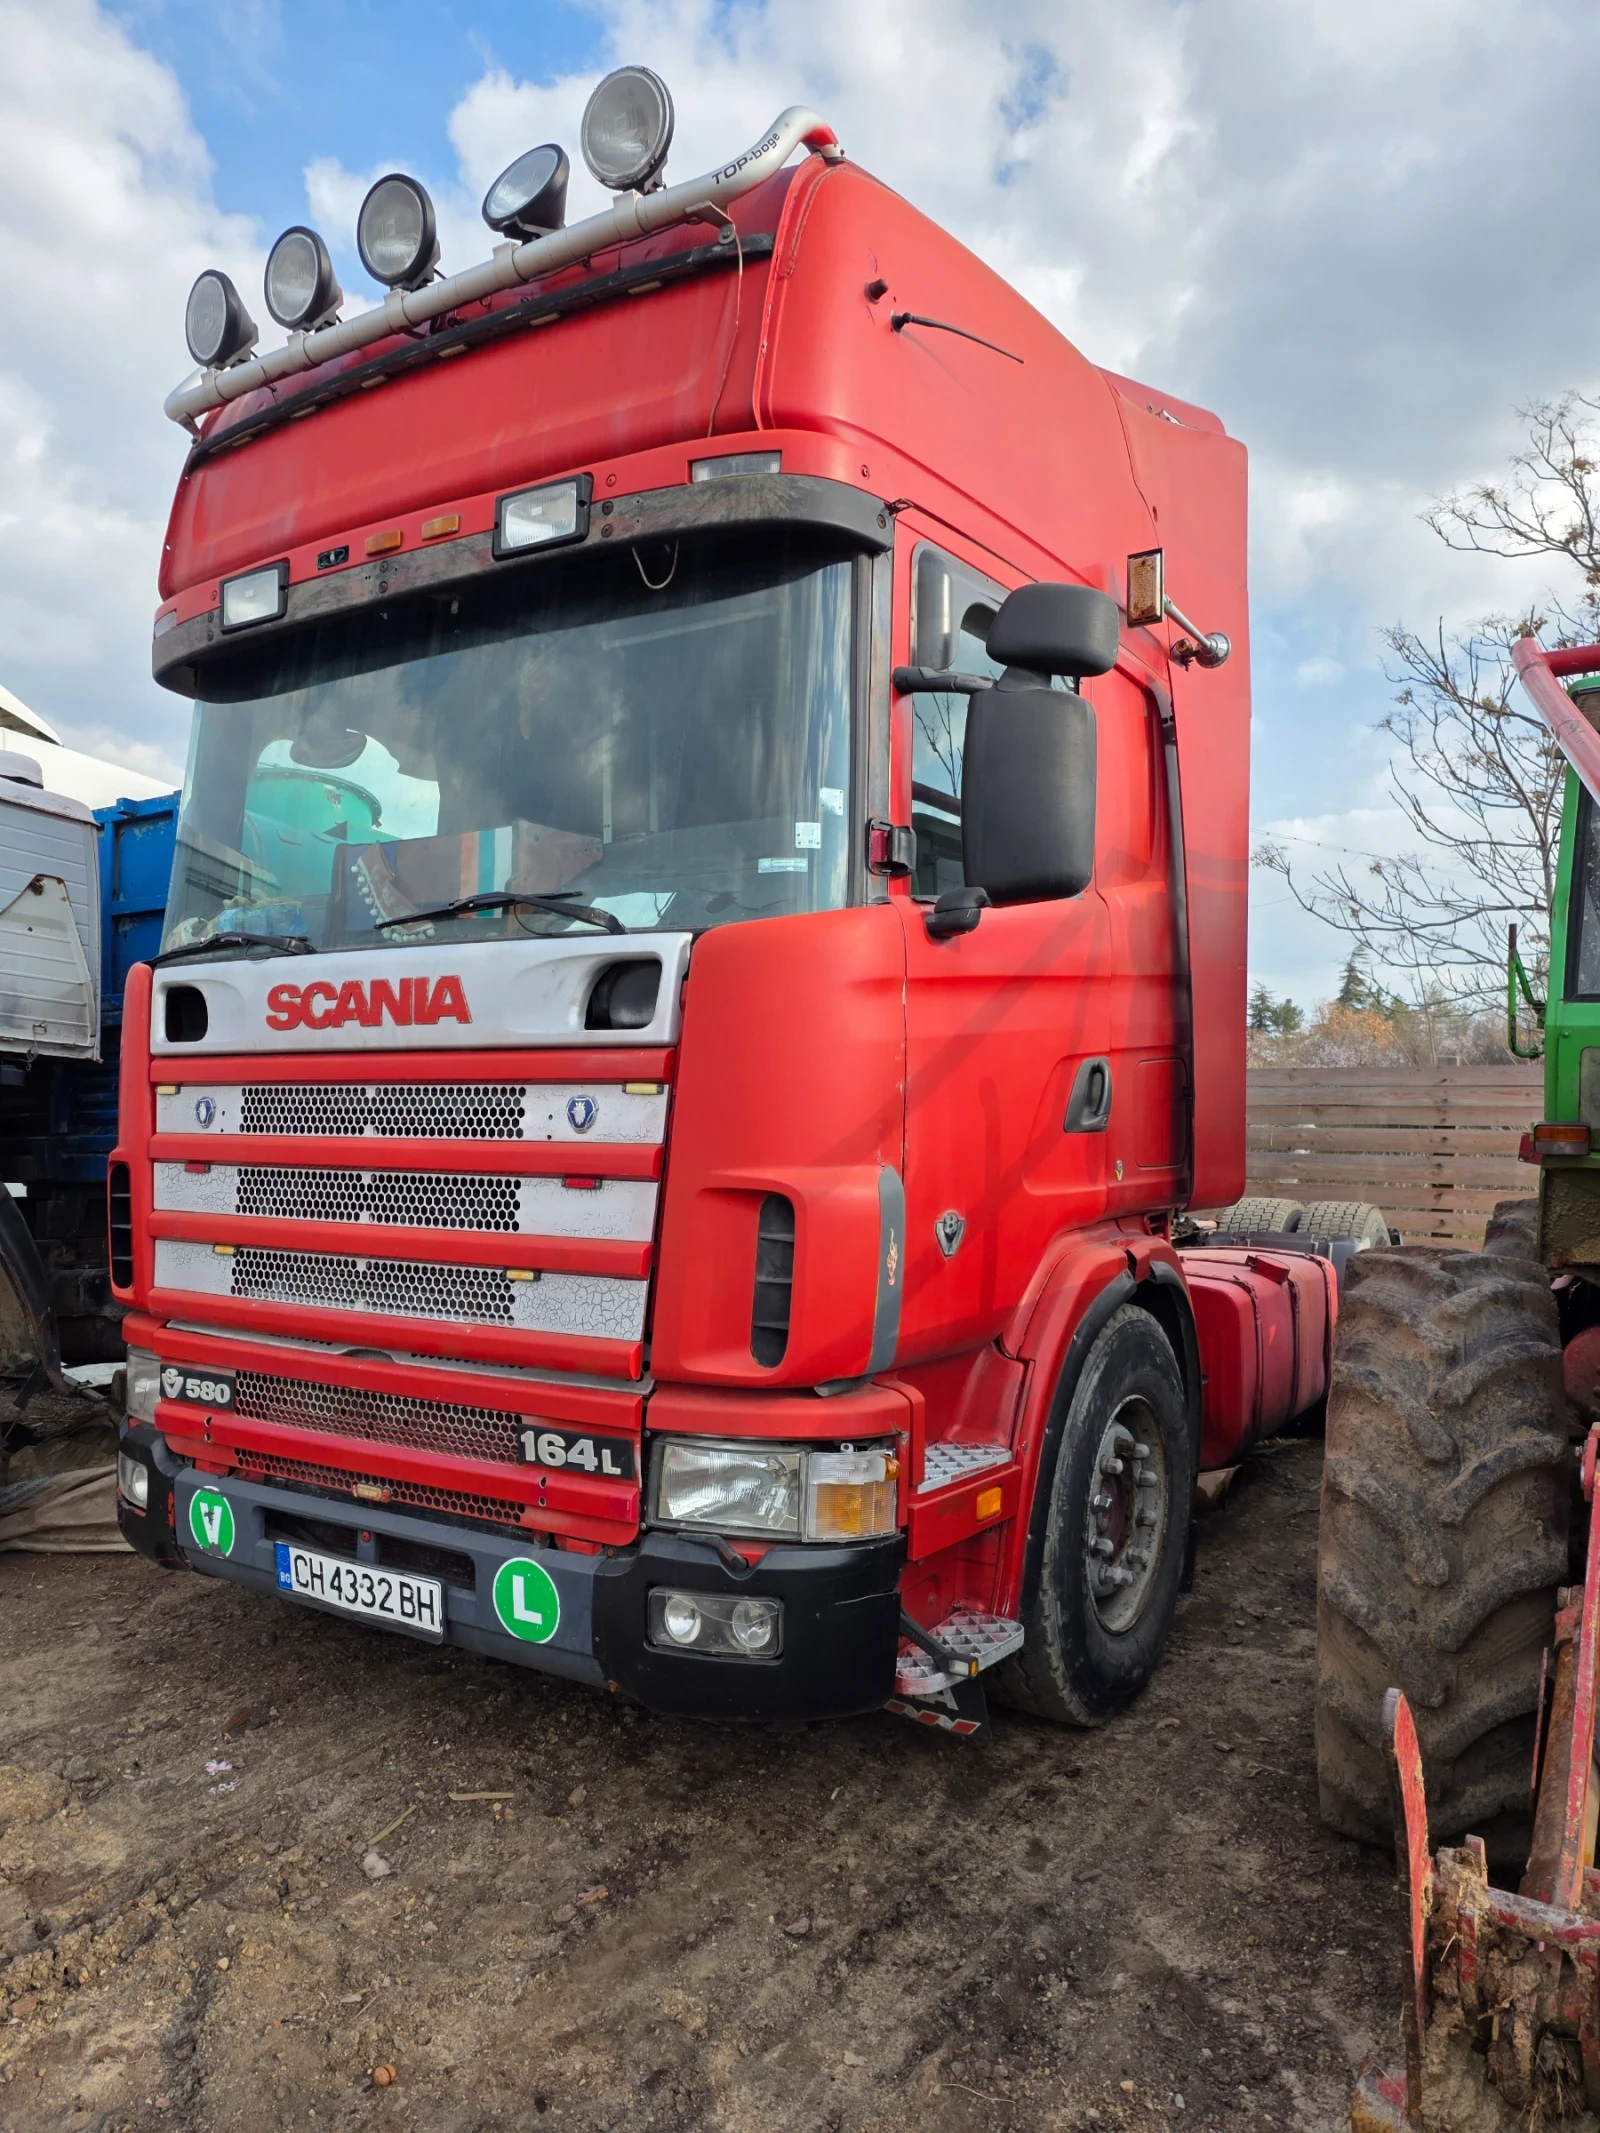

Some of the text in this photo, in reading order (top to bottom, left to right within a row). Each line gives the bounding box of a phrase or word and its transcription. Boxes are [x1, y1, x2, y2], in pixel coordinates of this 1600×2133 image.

[711, 132, 780, 185] TOP-boge
[265, 975, 473, 1031] SCANIA
[185, 1378, 231, 1404] 580
[199, 1501, 223, 1545] V
[280, 1571, 291, 1583] BG
[512, 1574, 543, 1626] L
